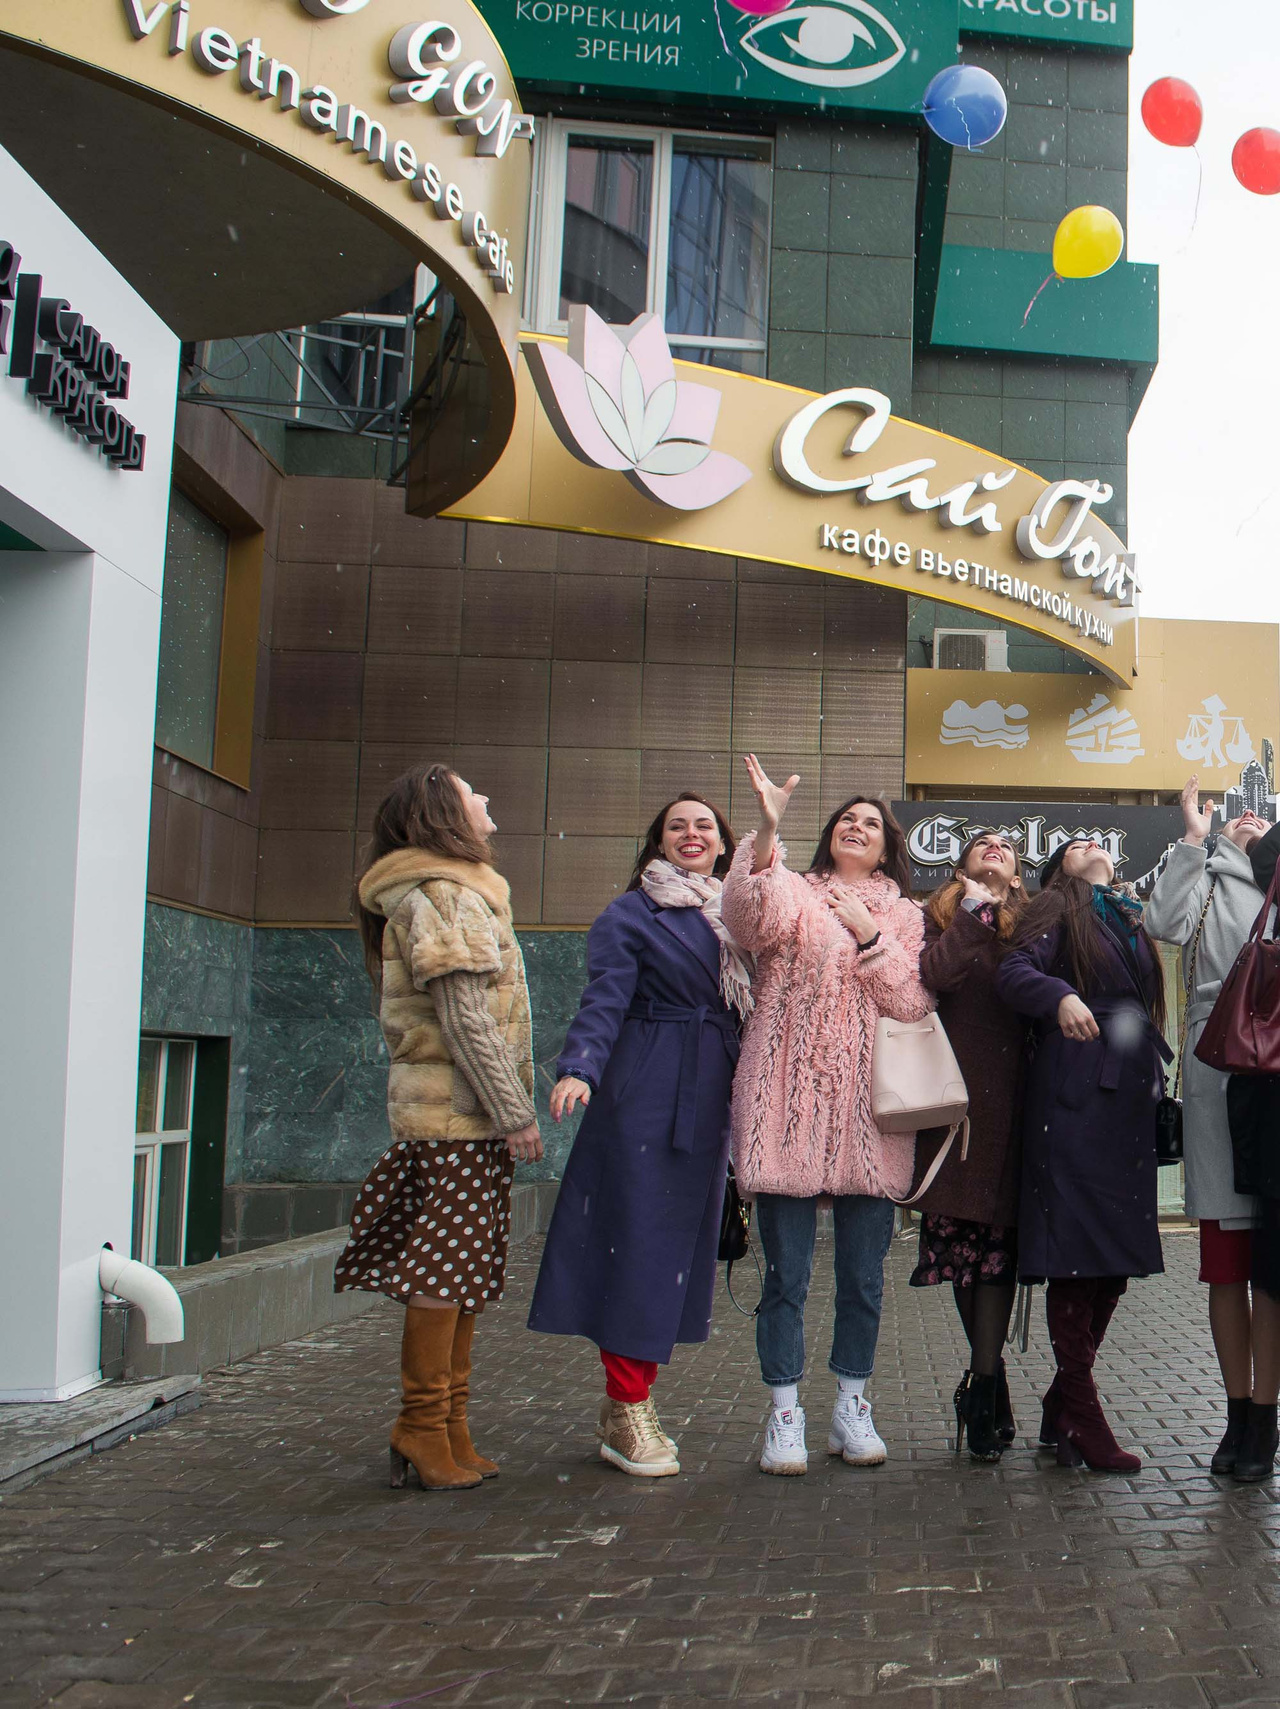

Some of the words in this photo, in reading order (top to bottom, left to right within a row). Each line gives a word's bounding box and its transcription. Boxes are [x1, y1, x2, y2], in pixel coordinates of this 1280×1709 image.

[516, 1, 681, 34] КОРРЕКЦИИ
[576, 37, 679, 66] ЗРЕНИЯ
[124, 0, 464, 221] vietnamese
[462, 211, 515, 295] cafe
[774, 387, 1017, 535] Сай
[820, 523, 912, 567] кафе
[917, 548, 1071, 622] вьетнамской
[1073, 607, 1114, 647] кухни
